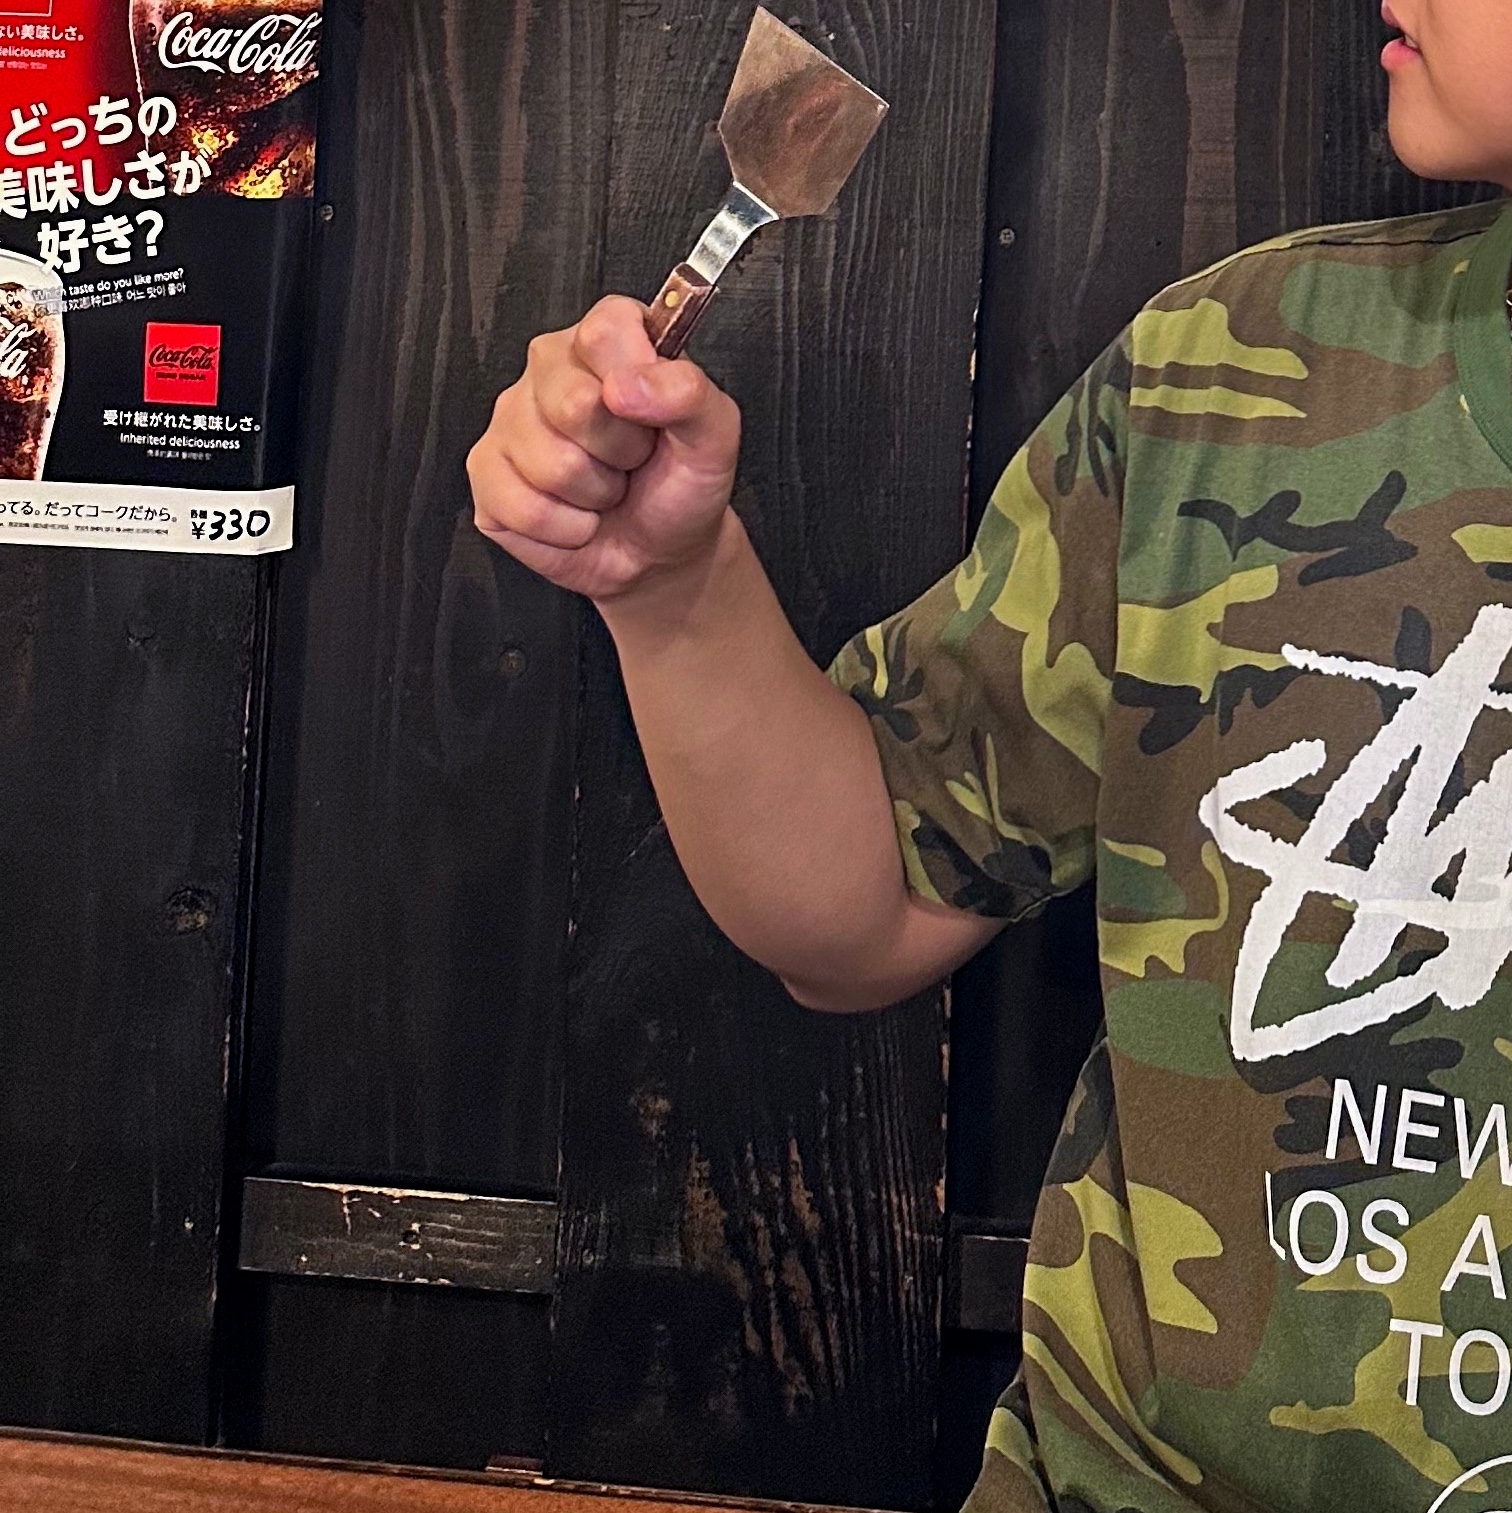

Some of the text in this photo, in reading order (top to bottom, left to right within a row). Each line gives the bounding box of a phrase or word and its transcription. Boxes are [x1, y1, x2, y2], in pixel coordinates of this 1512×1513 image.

[4, 96, 178, 156] どっちの
[37, 209, 164, 274] 好き?
[68, 283, 95, 296] taste
[97, 280, 111, 291] do
[113, 277, 132, 291] you
[153, 267, 184, 282] more?
[119, 432, 241, 450] Inherited deliciousness
